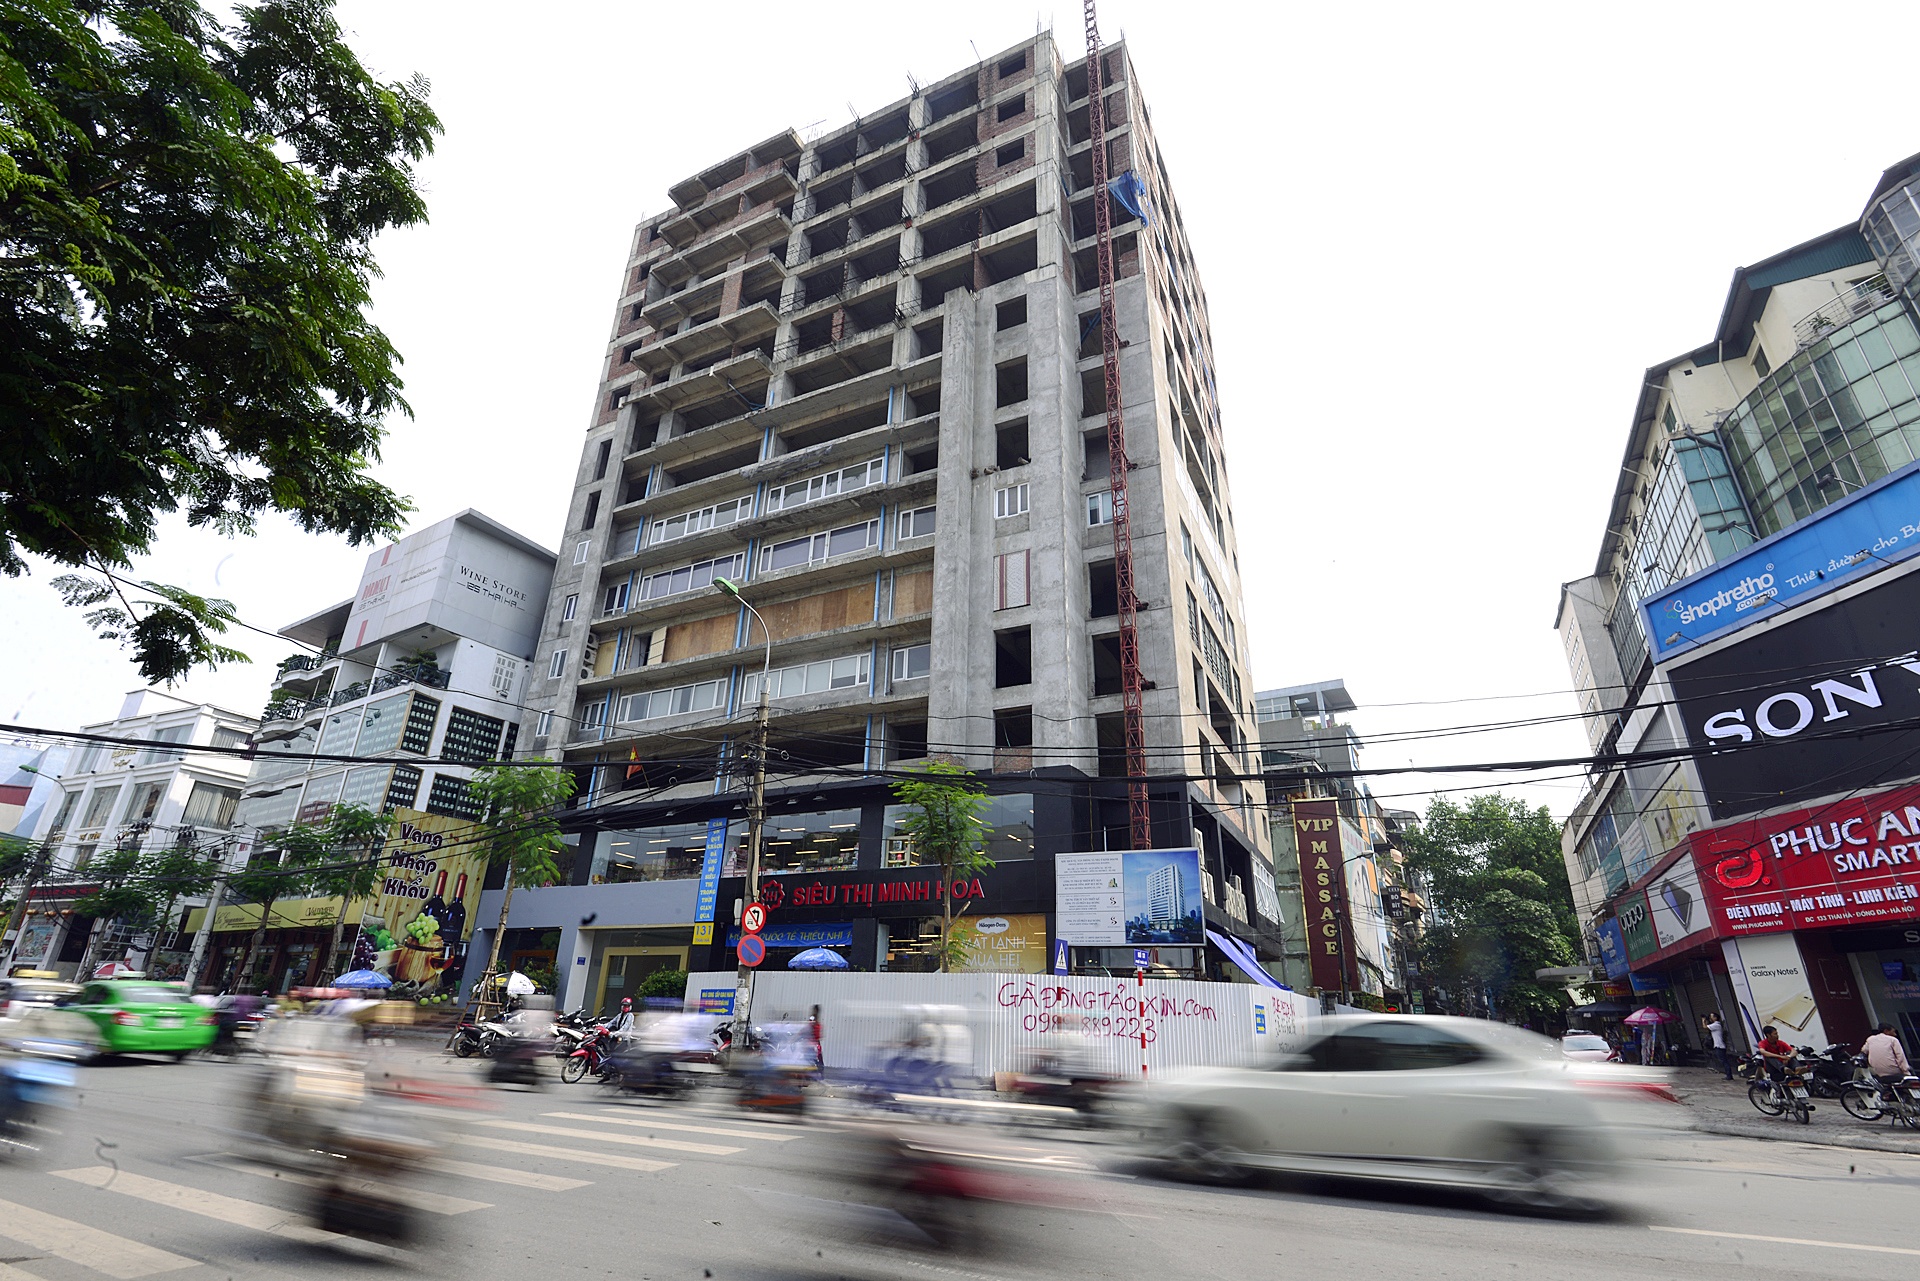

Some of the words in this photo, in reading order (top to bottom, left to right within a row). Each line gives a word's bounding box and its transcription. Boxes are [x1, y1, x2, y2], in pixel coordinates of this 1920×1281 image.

[1873, 536, 1898, 552] cho
[460, 565, 489, 585] WINE
[492, 580, 527, 601] STORE
[1680, 573, 1774, 625] shoptretho
[401, 822, 443, 850] Vang
[1297, 818, 1334, 832] VIP
[390, 850, 437, 876] Nhập
[384, 877, 430, 899] Khẩu
[793, 881, 836, 905] SIÊU
[841, 883, 874, 907] THỊ
[878, 880, 929, 903] MINH
[1311, 840, 1339, 955] MASSAGE
[1726, 903, 1751, 922] ĐIỆN
[1750, 902, 1784, 918] THOẠI
[1790, 894, 1816, 913] MÁY
[1815, 892, 1846, 909] TÍNH
[1852, 891, 1884, 905] LINH
[1884, 881, 1919, 903] KIỆN
[696, 924, 712, 936] 131
[1620, 904, 1643, 934] oppo
[1751, 969, 1776, 977] Galaxy
